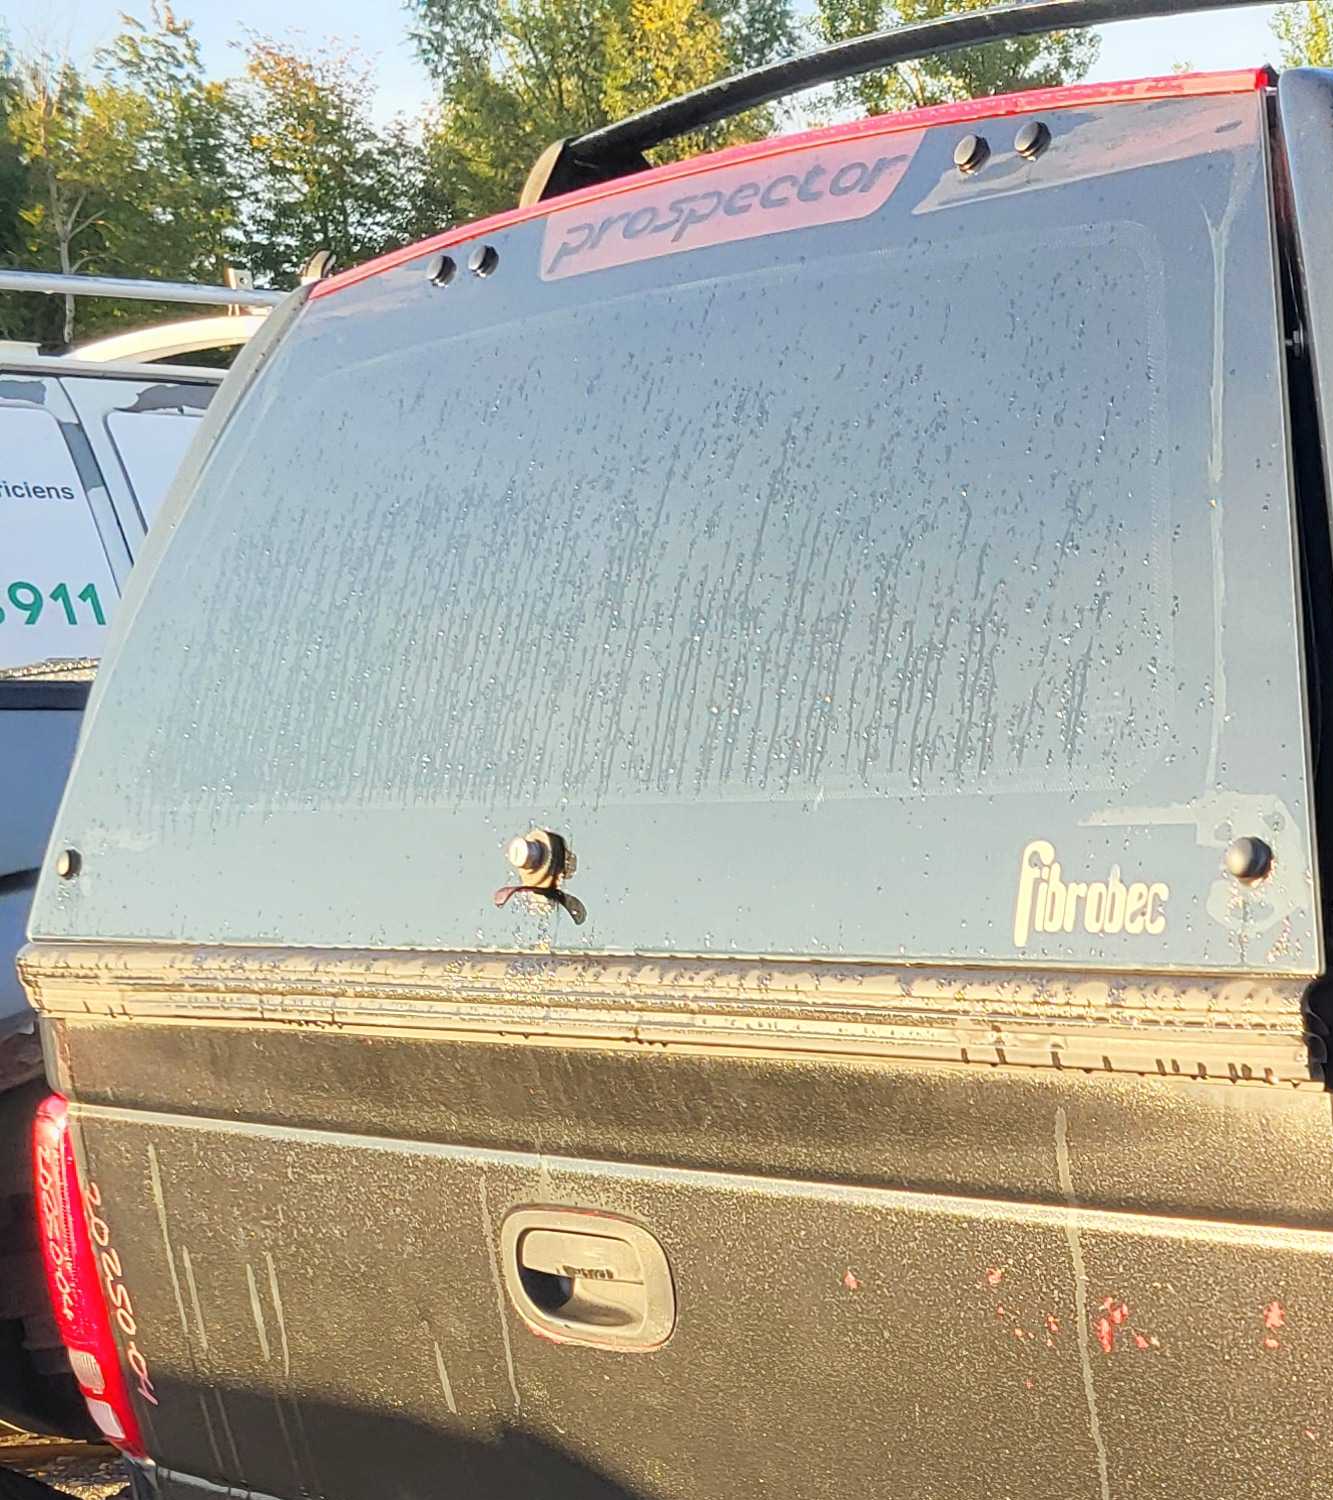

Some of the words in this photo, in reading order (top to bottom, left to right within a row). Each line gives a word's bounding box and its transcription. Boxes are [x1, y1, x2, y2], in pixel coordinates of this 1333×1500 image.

[546, 153, 908, 274] prospector
[0, 581, 106, 625] 911
[1013, 840, 1170, 948] fibrobec
